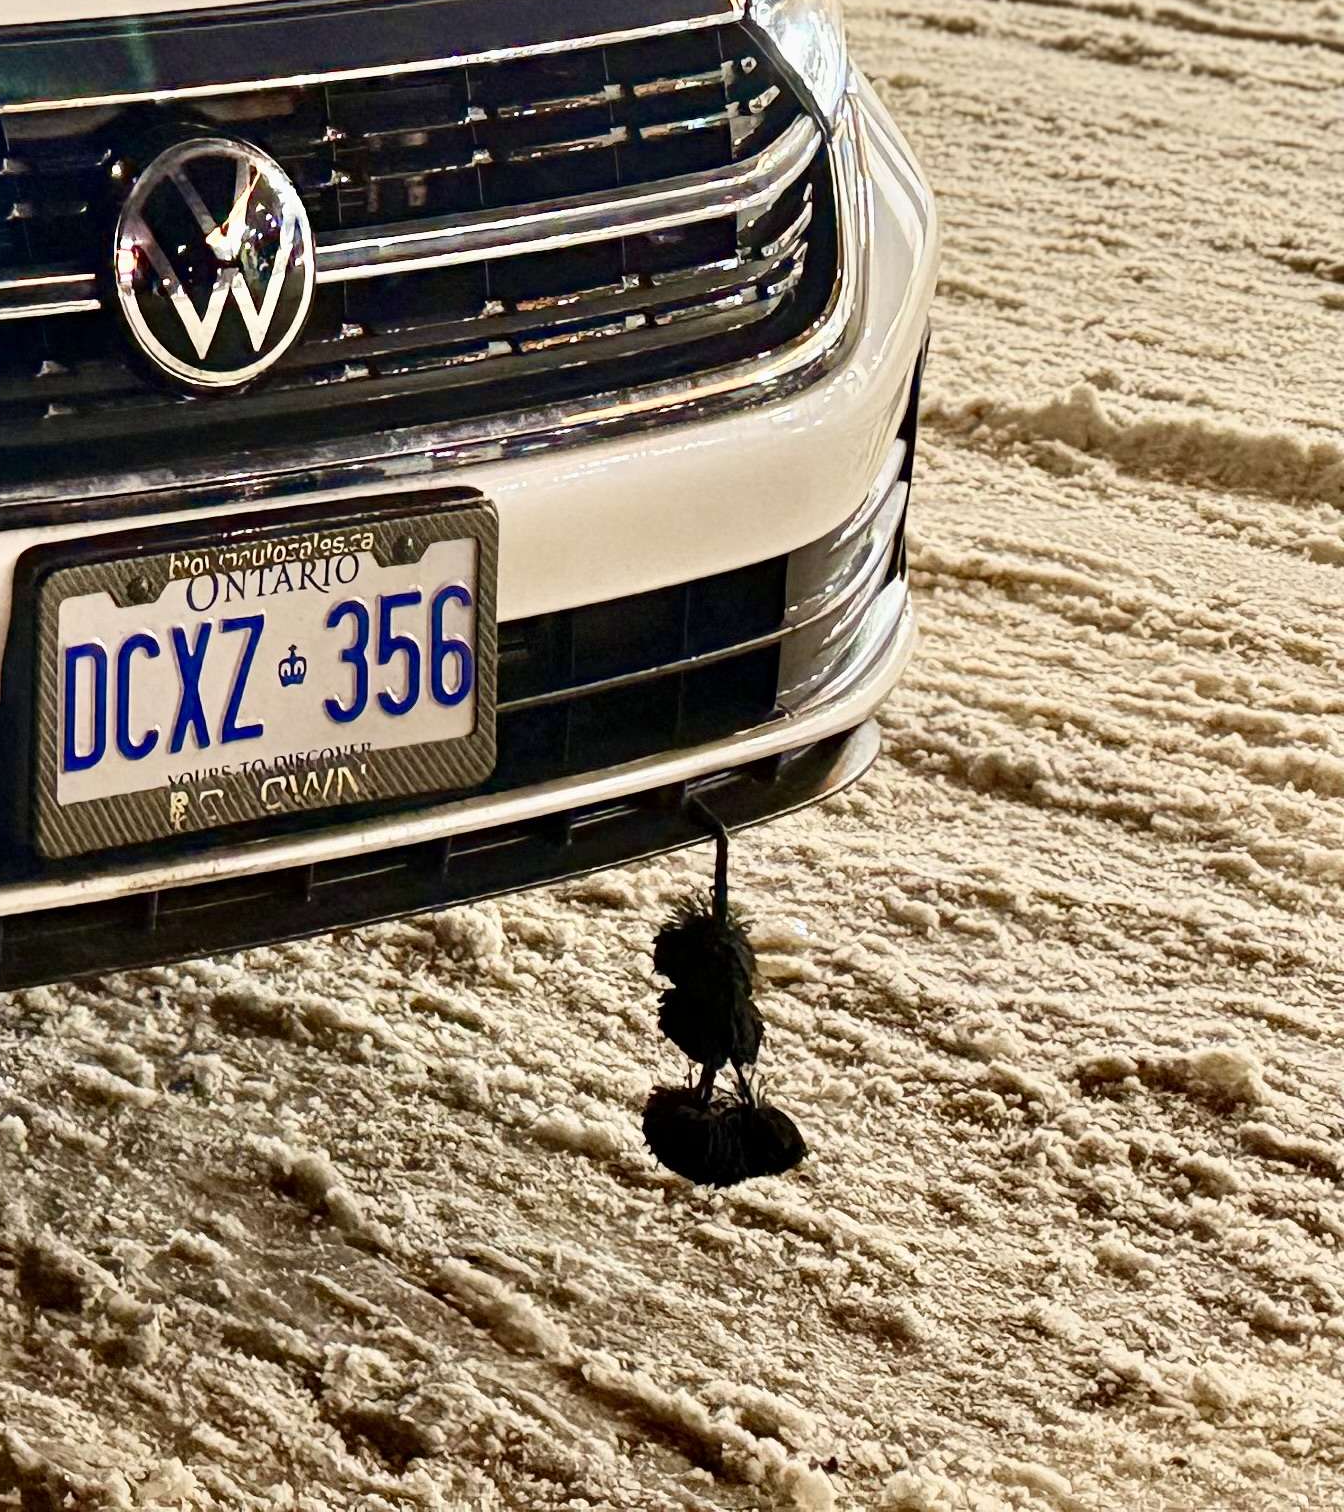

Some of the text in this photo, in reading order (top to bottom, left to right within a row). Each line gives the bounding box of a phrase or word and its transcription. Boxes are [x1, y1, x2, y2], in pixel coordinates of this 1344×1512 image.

[185, 553, 360, 612] ONTARIO
[62, 584, 475, 773] DCXZ 356
[240, 758, 266, 777] TO
